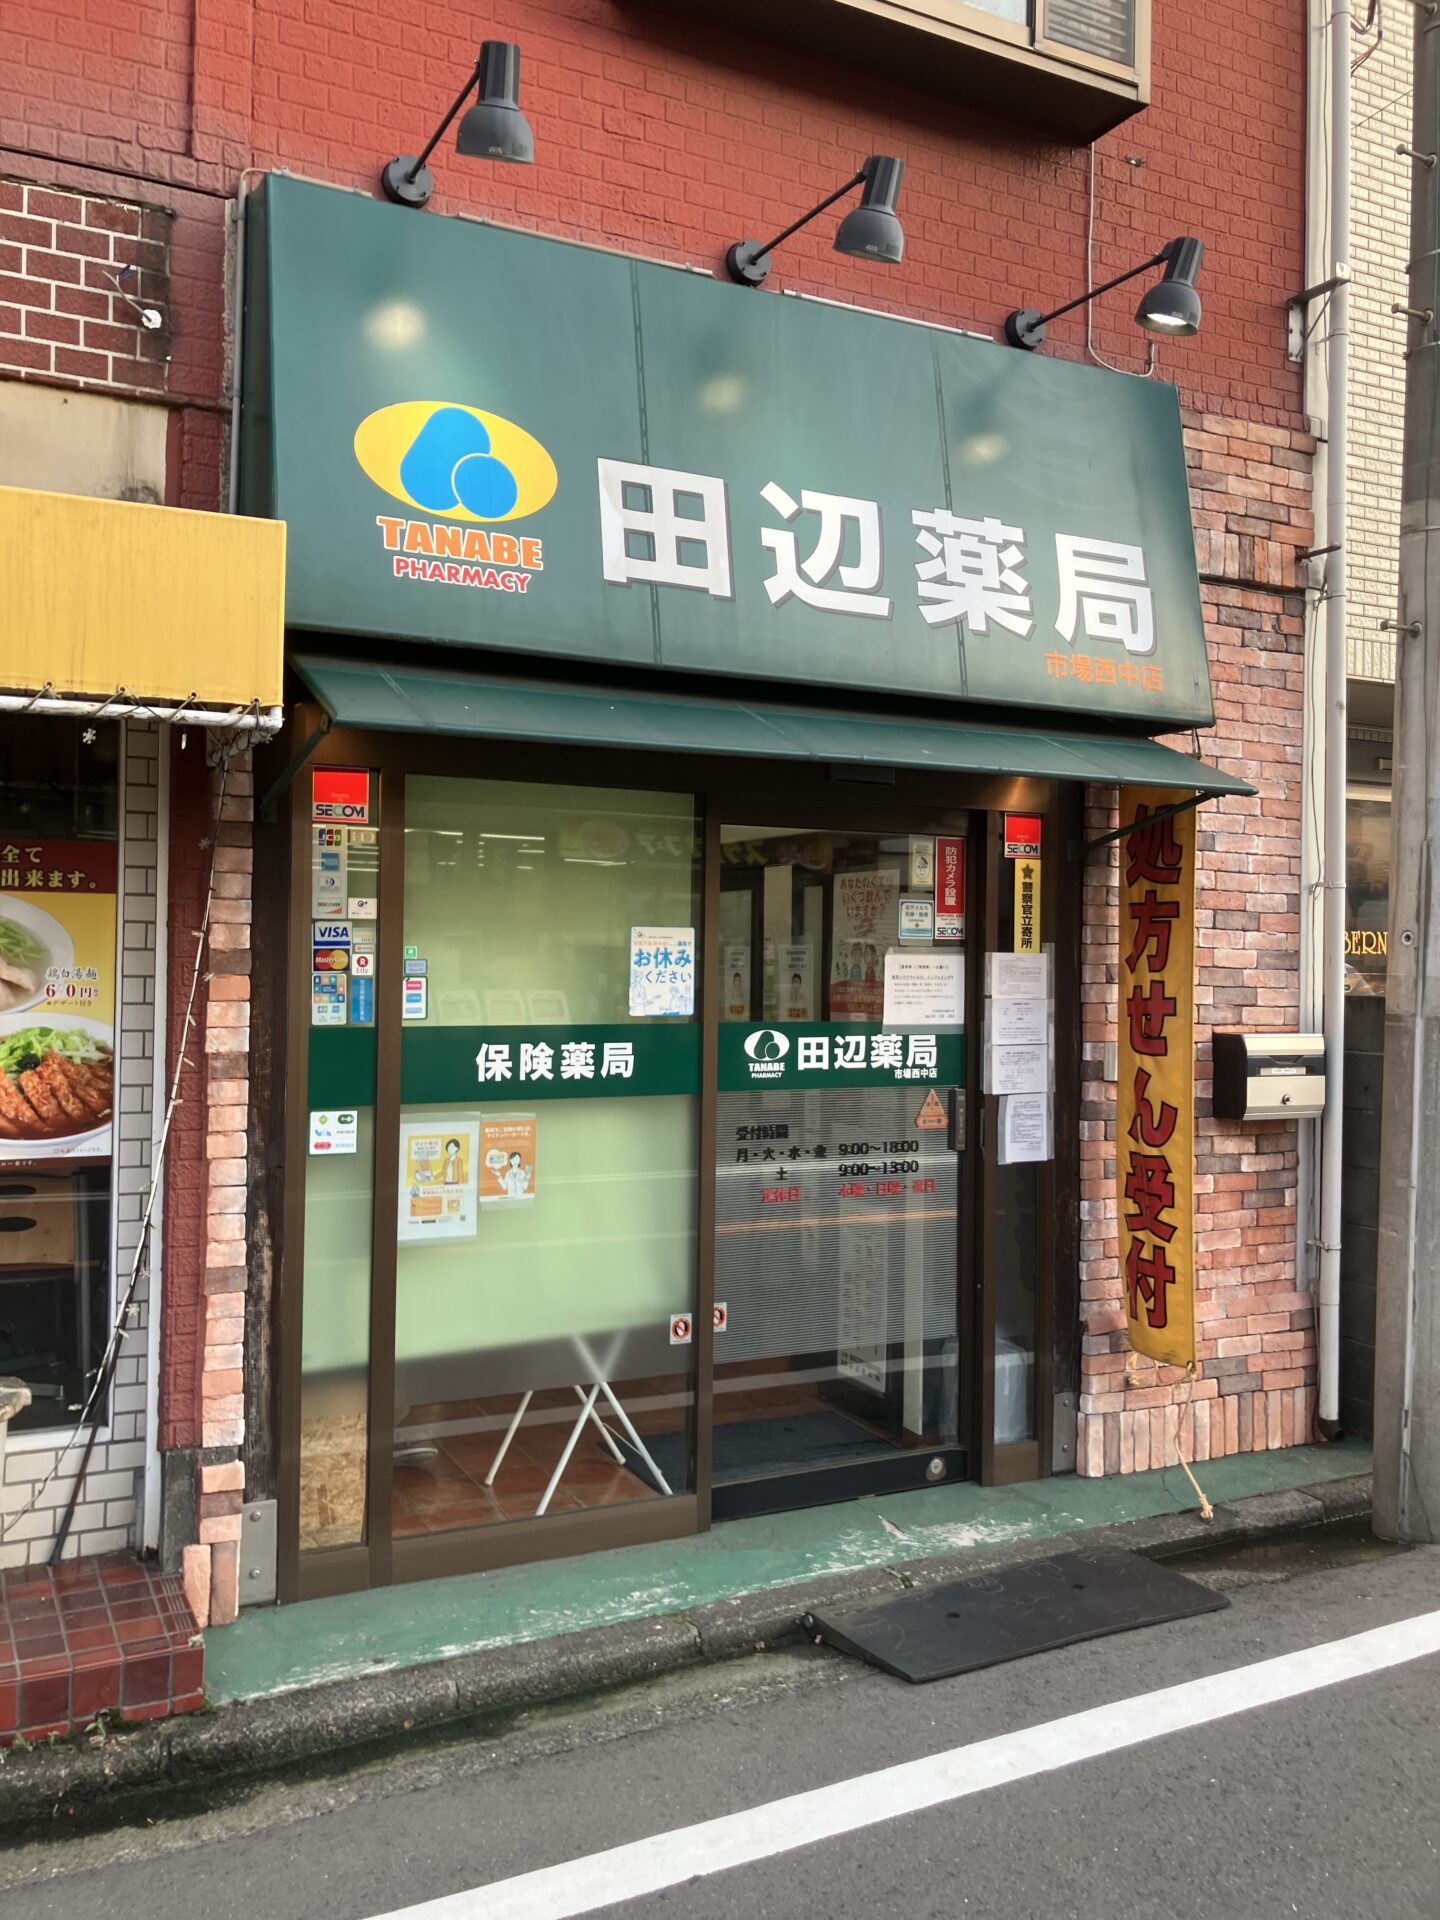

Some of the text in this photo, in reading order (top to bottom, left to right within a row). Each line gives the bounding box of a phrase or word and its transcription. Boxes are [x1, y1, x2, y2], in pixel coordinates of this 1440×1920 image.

[376, 516, 543, 570] TANABE
[597, 457, 1157, 655] 田辺薬局
[393, 556, 531, 593] PHARMACY
[1044, 651, 1163, 692] 市場西中店
[316, 804, 365, 818] SECOM
[319, 829, 342, 846] JCB
[1, 844, 44, 863] 全て
[1007, 843, 1038, 854] SECOM
[1, 868, 97, 889] 出来ます。
[944, 846, 958, 906] 防犯カメラ設置
[1020, 881, 1034, 950] 警察官立寄所
[319, 926, 349, 938] VISA
[937, 927, 964, 936] SECOM
[633, 946, 691, 969] お休み
[645, 970, 692, 984] ください
[797, 1034, 937, 1070] 田辺薬局
[475, 1042, 635, 1082] 保険薬局
[748, 1062, 785, 1072] TANABE
[1125, 803, 1183, 1329] 処方せん受付
[894, 1068, 938, 1079] 市場西中店
[735, 1123, 789, 1141] 受付時間
[775, 1166, 788, 1181] 土
[762, 1185, 801, 1203] 定休日
